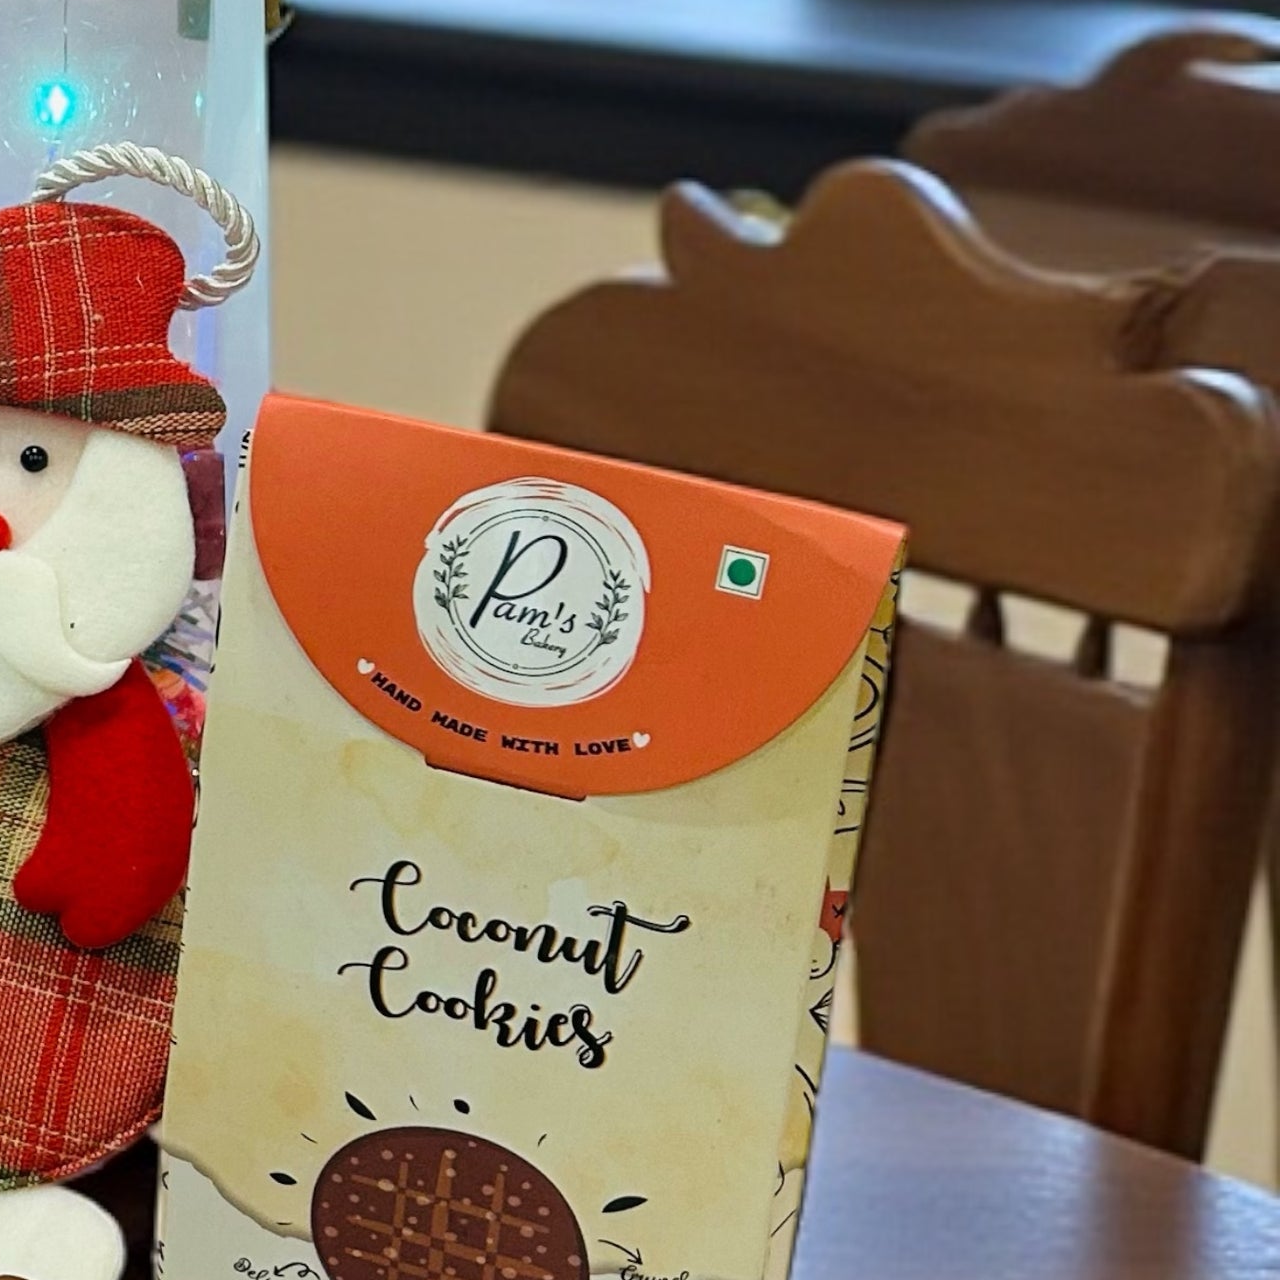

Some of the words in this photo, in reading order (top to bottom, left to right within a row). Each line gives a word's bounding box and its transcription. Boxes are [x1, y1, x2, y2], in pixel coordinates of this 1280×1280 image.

[469, 529, 578, 634] Pam's
[520, 628, 567, 658] Bakery
[370, 671, 422, 714] HAND
[431, 709, 488, 743] MADE
[501, 735, 560, 756] WITH
[574, 736, 632, 757] LOVE
[350, 860, 690, 994] Coconut
[337, 946, 613, 1070] Cookies
